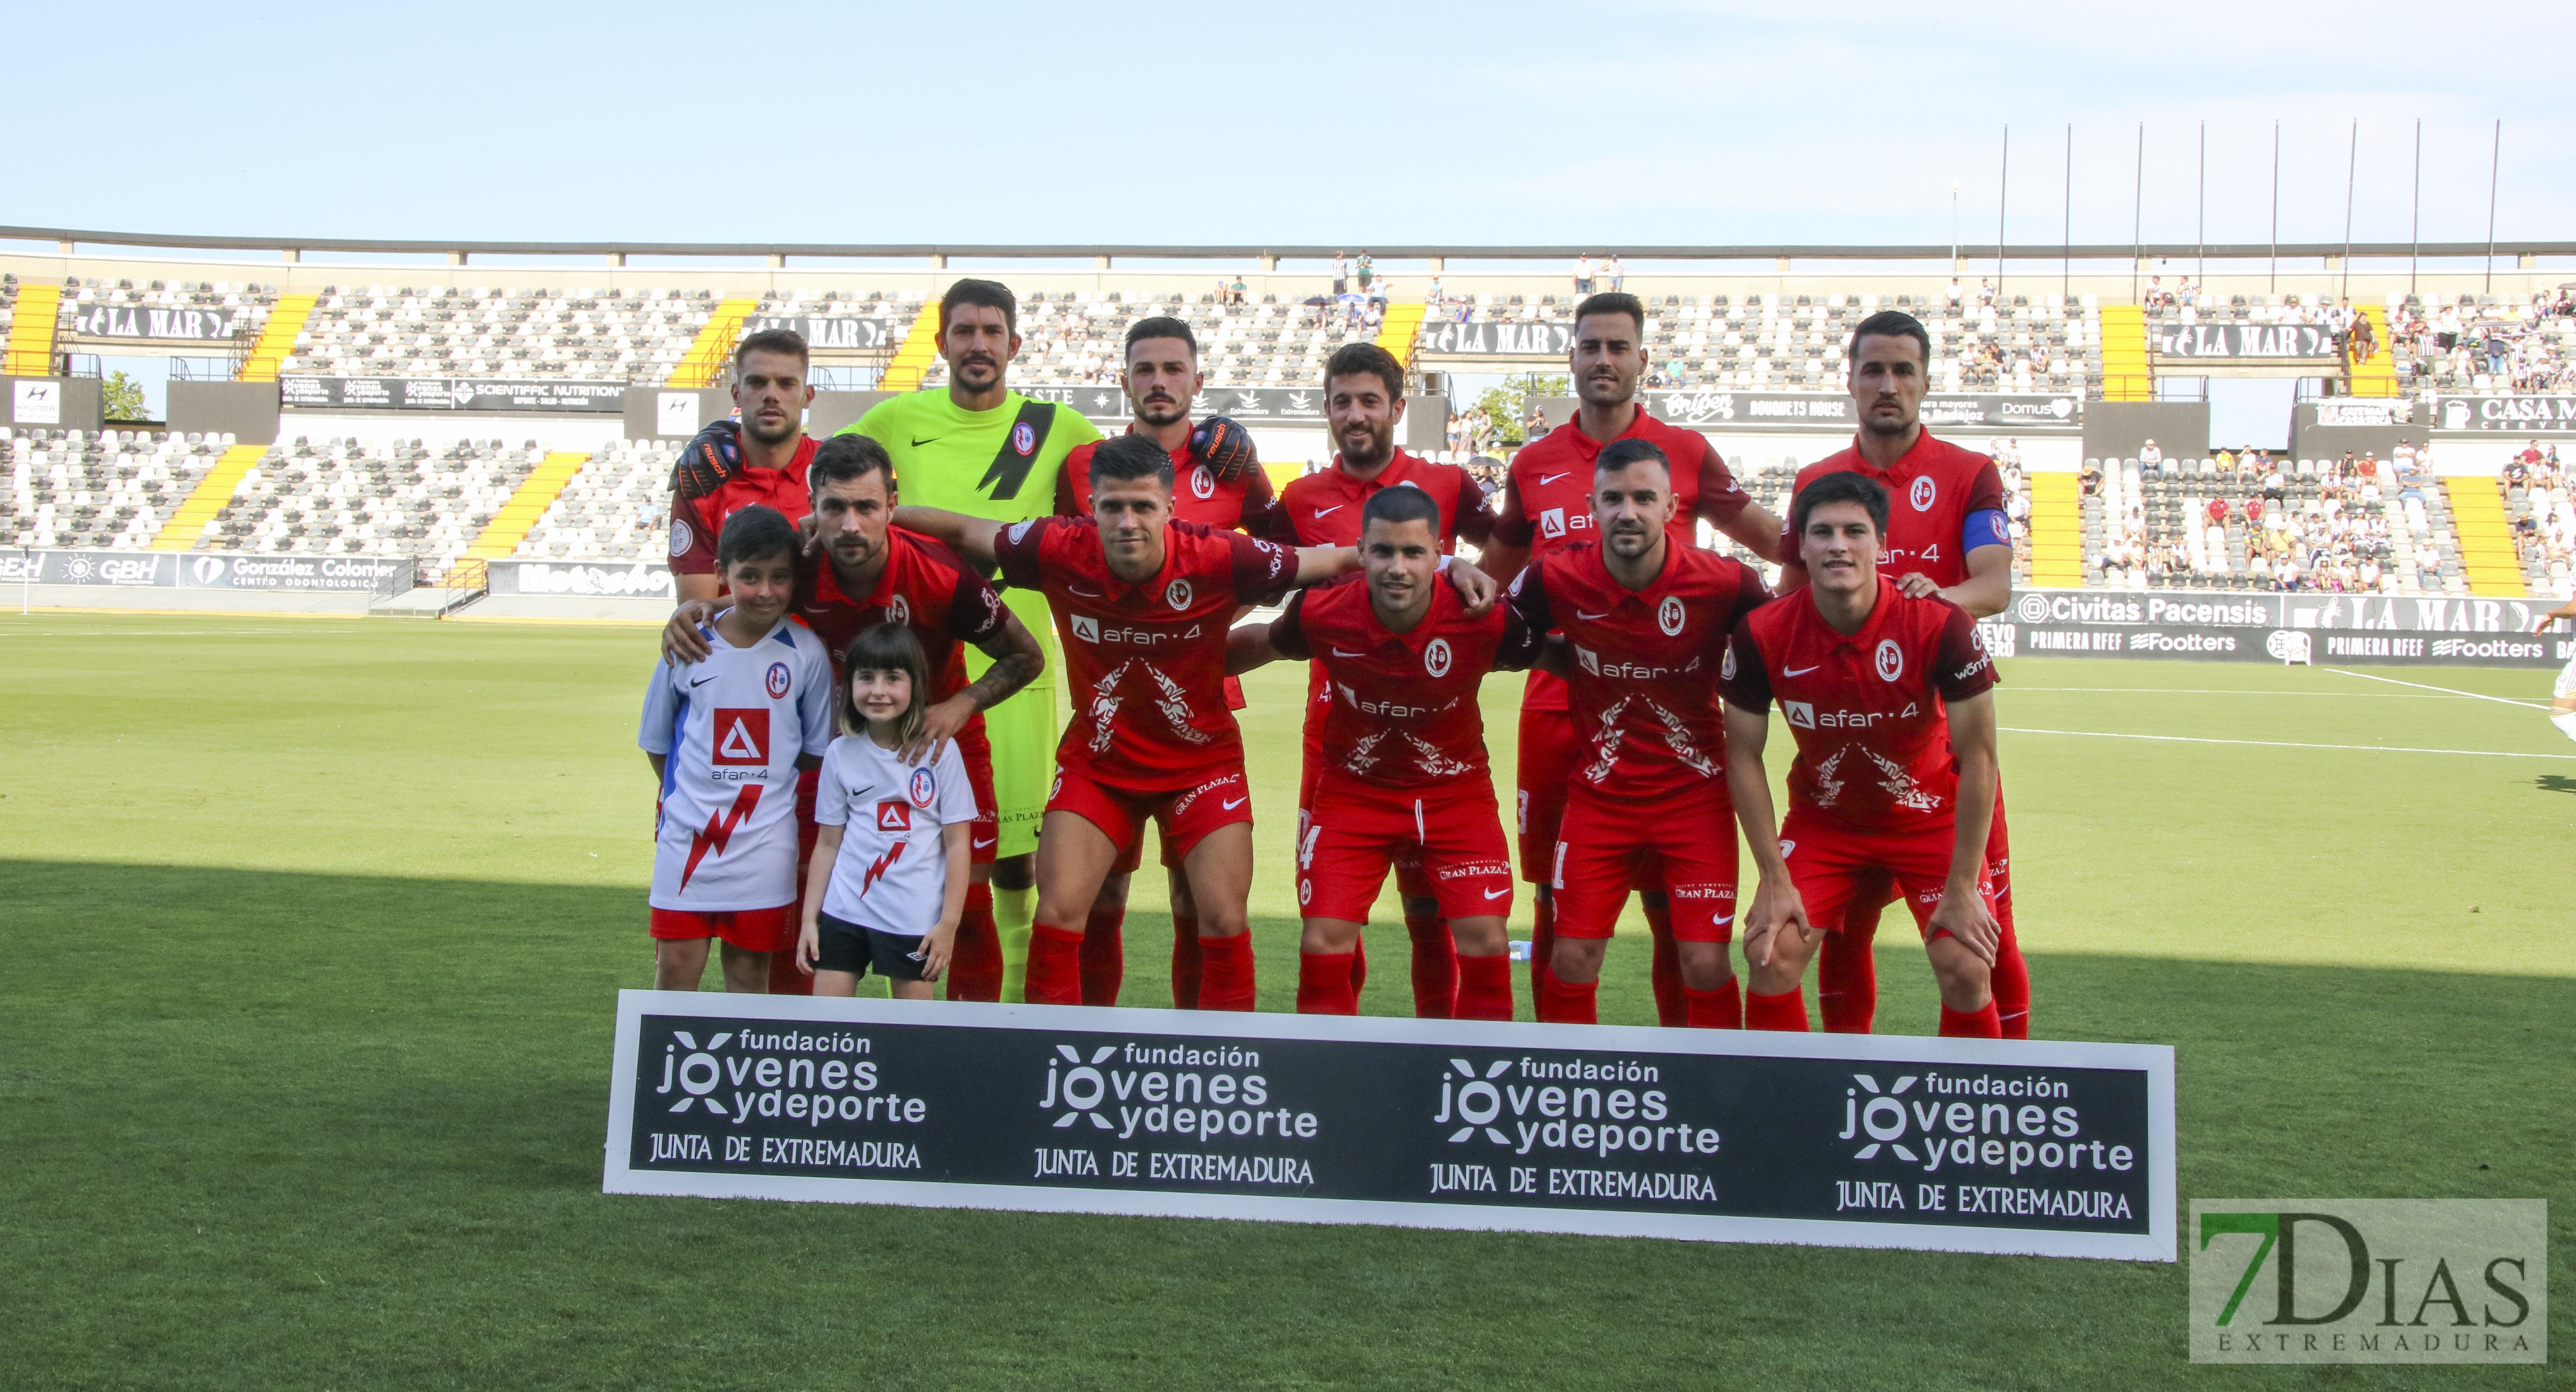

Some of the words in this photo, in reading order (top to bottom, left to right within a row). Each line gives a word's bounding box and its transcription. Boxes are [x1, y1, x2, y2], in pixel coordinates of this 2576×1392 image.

[107, 308, 140, 336] LA
[148, 310, 203, 338] MAR
[808, 320, 859, 347] MAR
[1455, 324, 1487, 352] LA
[1495, 325, 1549, 353] MAR
[2194, 327, 2230, 356] LA
[2239, 327, 2299, 356] MAR
[476, 385, 549, 396] SCIENTIFFIC
[562, 397, 589, 406] NUTRICIÓN
[1750, 401, 1806, 415] BOUQUETS
[1810, 401, 1844, 416] HOUSE
[1932, 409, 1984, 423] Badajoz
[1939, 401, 1978, 410] mayores
[2002, 403, 2051, 415] Domus
[2481, 399, 2553, 420] CASA
[1207, 423, 1227, 459] reusch
[703, 443, 726, 478] reusch
[100, 555, 159, 584] GBH
[233, 558, 314, 576] González
[322, 559, 397, 578] Colomer
[285, 578, 379, 588] ODONTOLOGICO
[2052, 596, 2141, 621] Civitas
[2149, 598, 2267, 624] Pacensis
[2351, 597, 2398, 630] LA
[2415, 599, 2501, 632] MAR
[1976, 624, 2015, 641] EVO
[2031, 631, 2089, 649] PRIMERA
[2093, 632, 2122, 650] RFEF
[2149, 633, 2236, 651] Footters
[1982, 641, 2015, 657] ERO
[2328, 637, 2390, 656] PRIMERA
[2393, 639, 2424, 657] RFEF
[2452, 639, 2543, 658] Footters
[1176, 791, 1197, 815] GRAN
[1440, 868, 1466, 879] GRAN
[1676, 889, 1701, 898] GRAN
[740, 1029, 871, 1053] fundación
[1125, 1043, 1258, 1067] fundación
[1520, 1057, 1658, 1082] fundación
[1926, 1073, 2068, 1098] fundación
[733, 1090, 926, 1127] ydeporte
[1118, 1104, 1317, 1142] ydeporte
[650, 1133, 713, 1162] JUNTA
[726, 1136, 751, 1161] DE
[762, 1138, 921, 1168] EXTREMADURA
[1516, 1119, 1719, 1158] ydeporte
[1035, 1149, 1099, 1177] JUNTA
[1112, 1152, 1138, 1177] DE
[1150, 1153, 1314, 1184] EXTREMADURA
[1924, 1136, 2132, 1174] ydeporte
[1431, 1164, 1497, 1193] JUNTA
[1510, 1167, 1537, 1193] DE
[1549, 1169, 1717, 1201] EXTREMADURA
[1836, 1181, 1905, 1211] JUNTA
[1919, 1184, 1946, 1210] DE
[1959, 1186, 2132, 1219] EXTREMADURA
